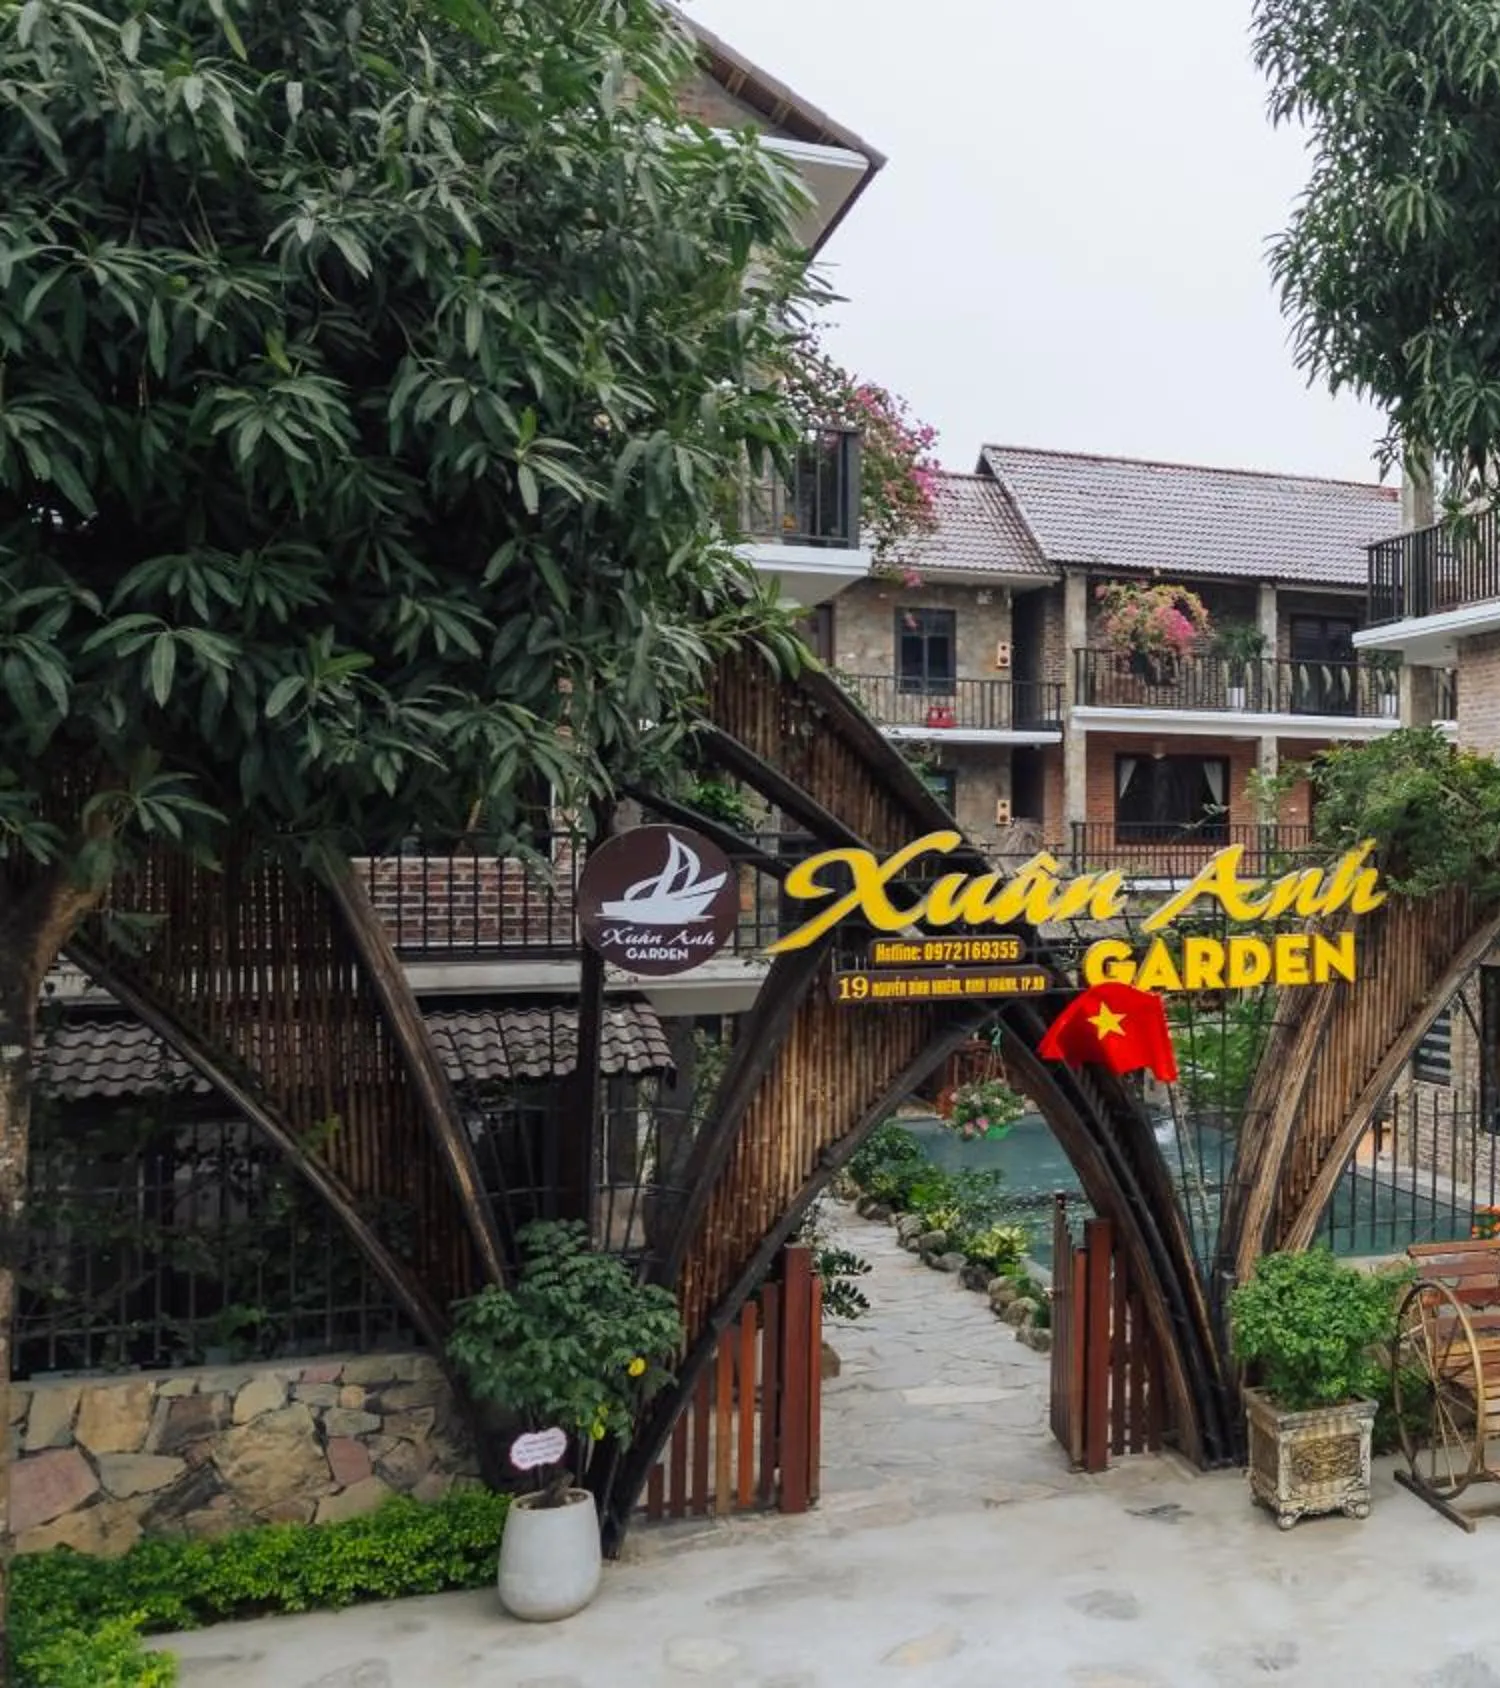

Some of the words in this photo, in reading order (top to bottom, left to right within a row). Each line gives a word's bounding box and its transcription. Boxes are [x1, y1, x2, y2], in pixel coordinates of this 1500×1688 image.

[766, 830, 1126, 955] Xuân
[1140, 838, 1387, 933] Anh
[667, 929, 716, 946] Anh
[626, 946, 689, 961] GARDEN
[875, 942, 922, 962] Hotline:
[924, 940, 1019, 961] 0972169355
[1083, 931, 1357, 993] GARDEN
[838, 975, 869, 999] 19
